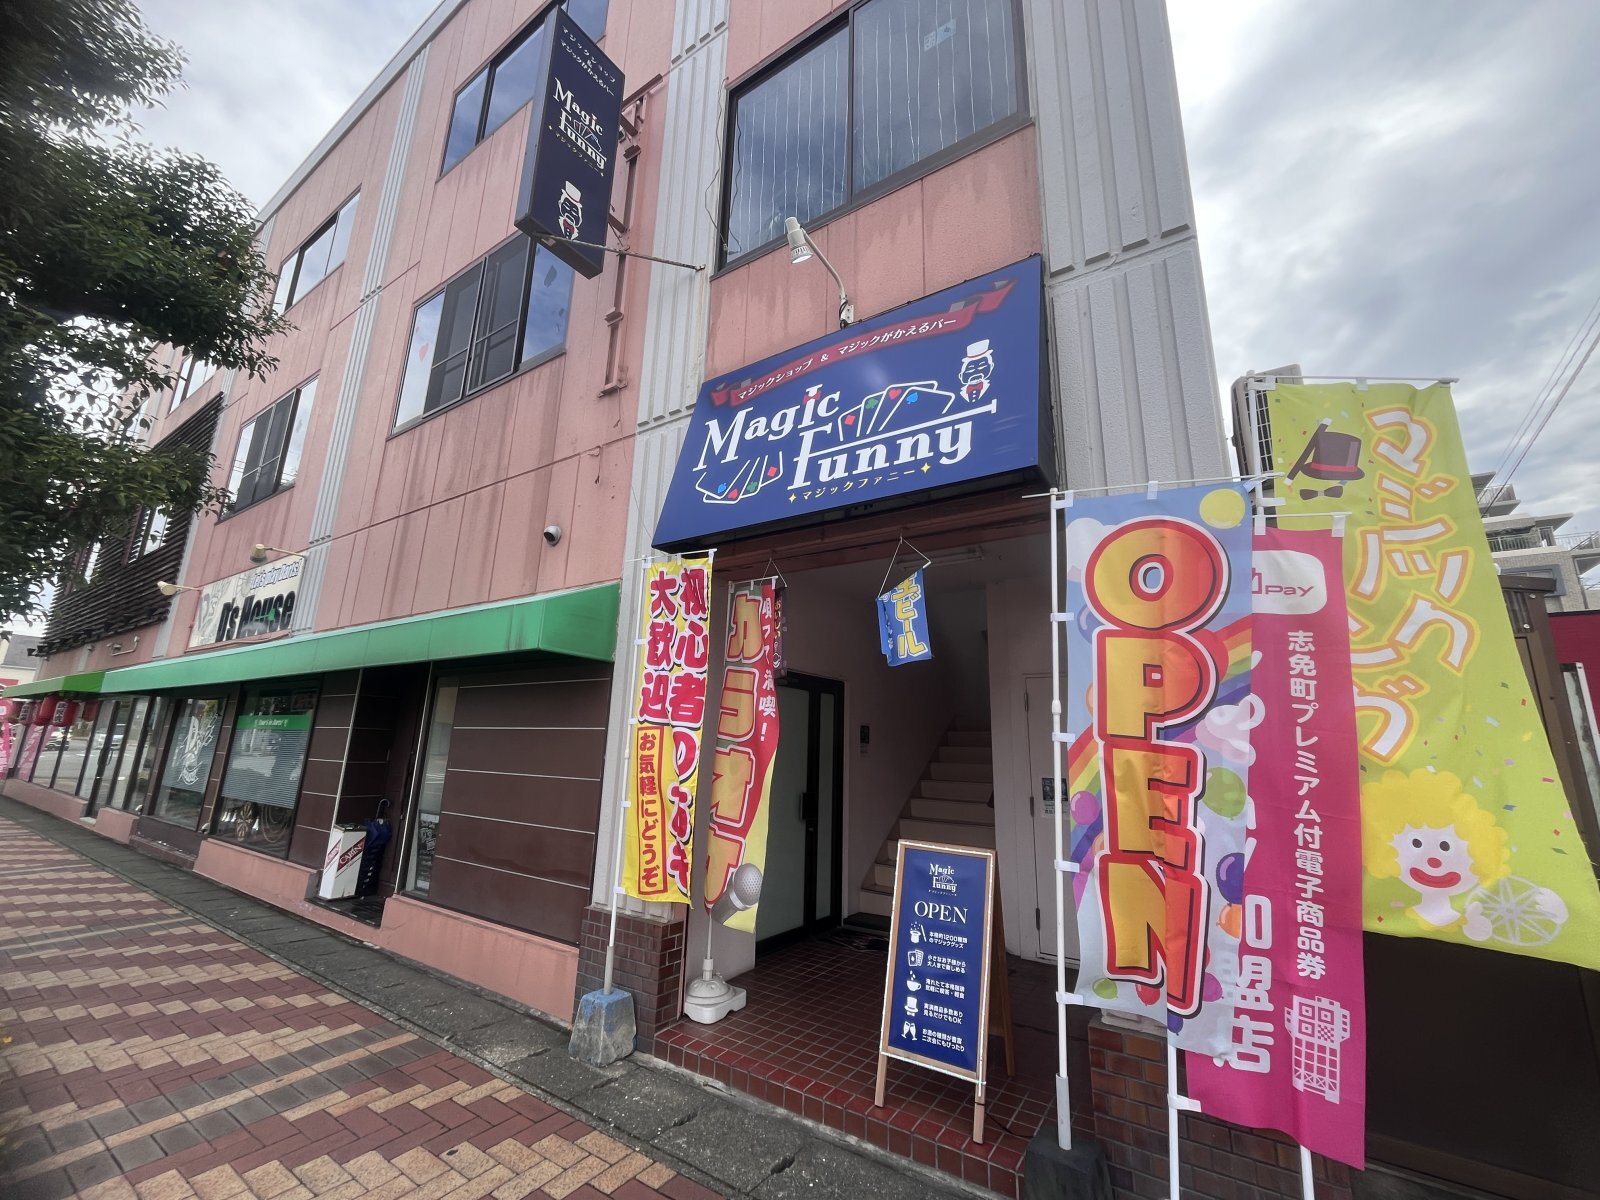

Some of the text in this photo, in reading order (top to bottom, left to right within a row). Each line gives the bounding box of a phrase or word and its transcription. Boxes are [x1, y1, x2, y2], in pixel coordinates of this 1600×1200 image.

[553, 77, 603, 136] Magic
[558, 108, 607, 170] Funny
[737, 318, 957, 400] マジックショップ & マジックがかえるバー
[693, 384, 840, 471] Magic
[787, 418, 980, 490] Funny
[802, 469, 916, 500] マジックファニー
[1366, 405, 1478, 676] マジック
[236, 590, 296, 639] House
[638, 570, 678, 721] 大歓迎
[704, 591, 764, 909] カラオケ
[1082, 515, 1230, 1018] OPEN
[639, 732, 659, 888] お気軽にどうぞ
[1287, 630, 1327, 979] 志免町プレミアム付電子商品券
[929, 863, 955, 876] Magic
[932, 876, 957, 893] Funny
[914, 900, 968, 925] OPEN
